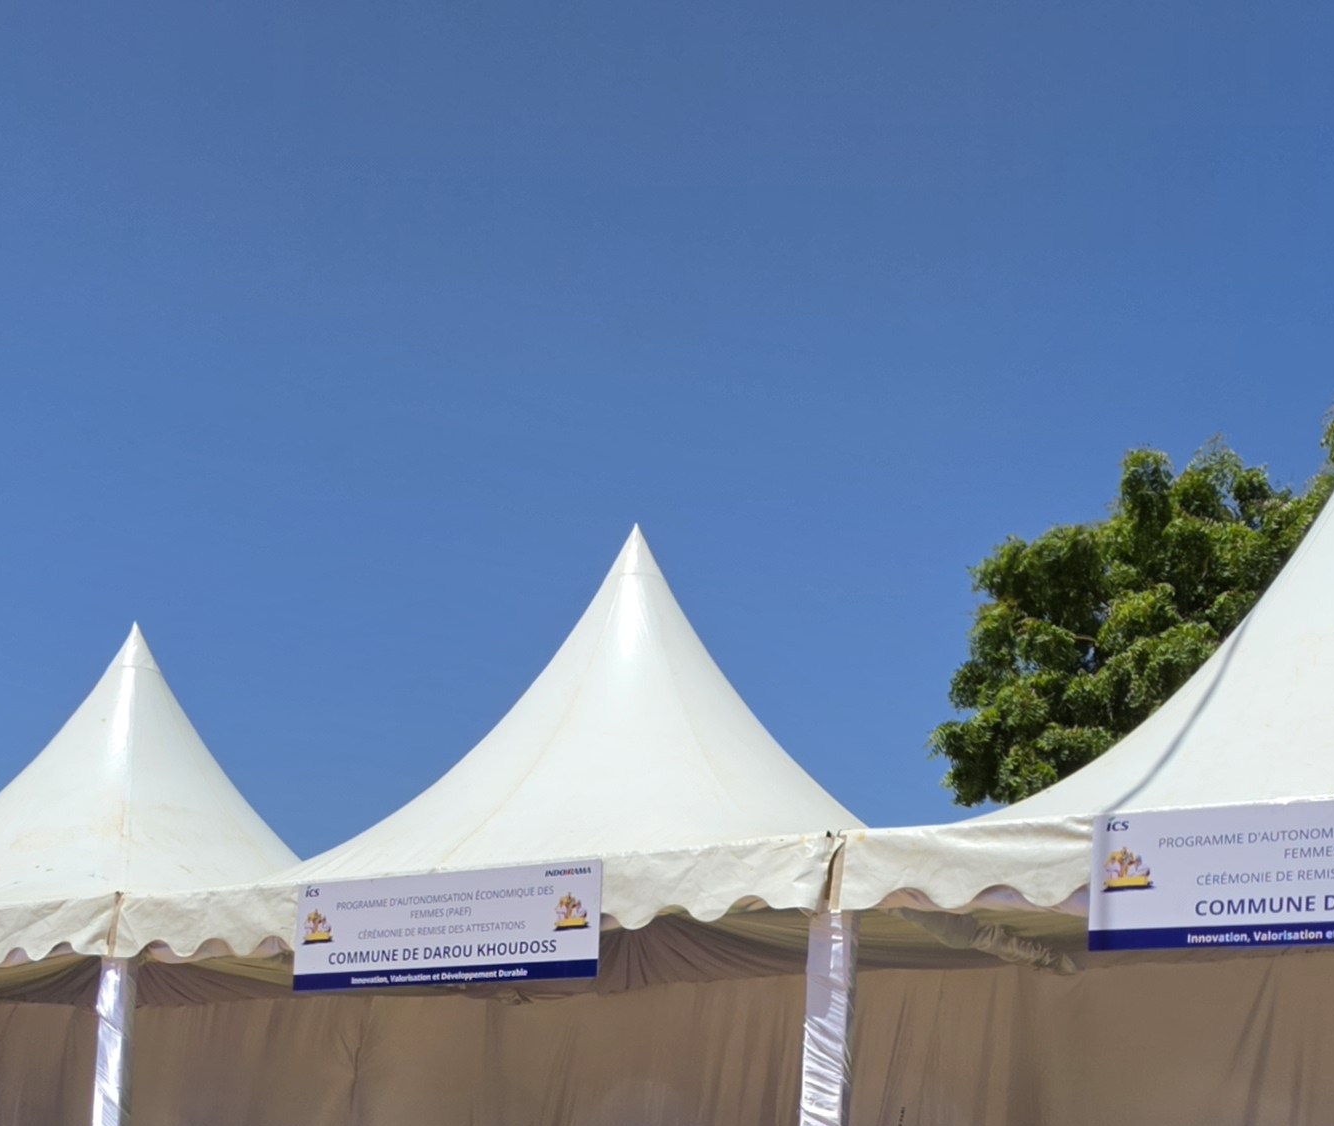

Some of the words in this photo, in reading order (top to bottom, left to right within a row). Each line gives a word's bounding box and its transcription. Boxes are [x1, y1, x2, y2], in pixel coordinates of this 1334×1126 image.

[1158, 833, 1244, 849] PROGRAMME
[1196, 871, 1273, 887] CÉRÉMONIE
[1276, 870, 1294, 882] DE
[336, 898, 388, 911] PROGRAMME
[389, 892, 473, 907] D'AUTONOMISATION
[475, 887, 535, 901] ÉCONOMIQUE
[537, 885, 554, 896] DES
[1195, 894, 1316, 916] COMMUNE
[410, 908, 444, 919] FEMMES
[446, 906, 472, 918] (PAEF)
[358, 928, 403, 940] CÉRÉMONIE
[405, 927, 415, 937] DE
[417, 925, 446, 936] REMISE
[448, 924, 464, 934] DES
[465, 920, 526, 933] ATTESTATIONS
[1187, 932, 1251, 944] Innovation,
[1253, 929, 1323, 942] Valorisation
[328, 949, 398, 965] COMMUNE
[402, 948, 419, 961] DE
[423, 944, 472, 960] DAROU
[477, 939, 557, 957] KHOUDOSS
[432, 973, 440, 981] et
[498, 968, 528, 977] Durable
